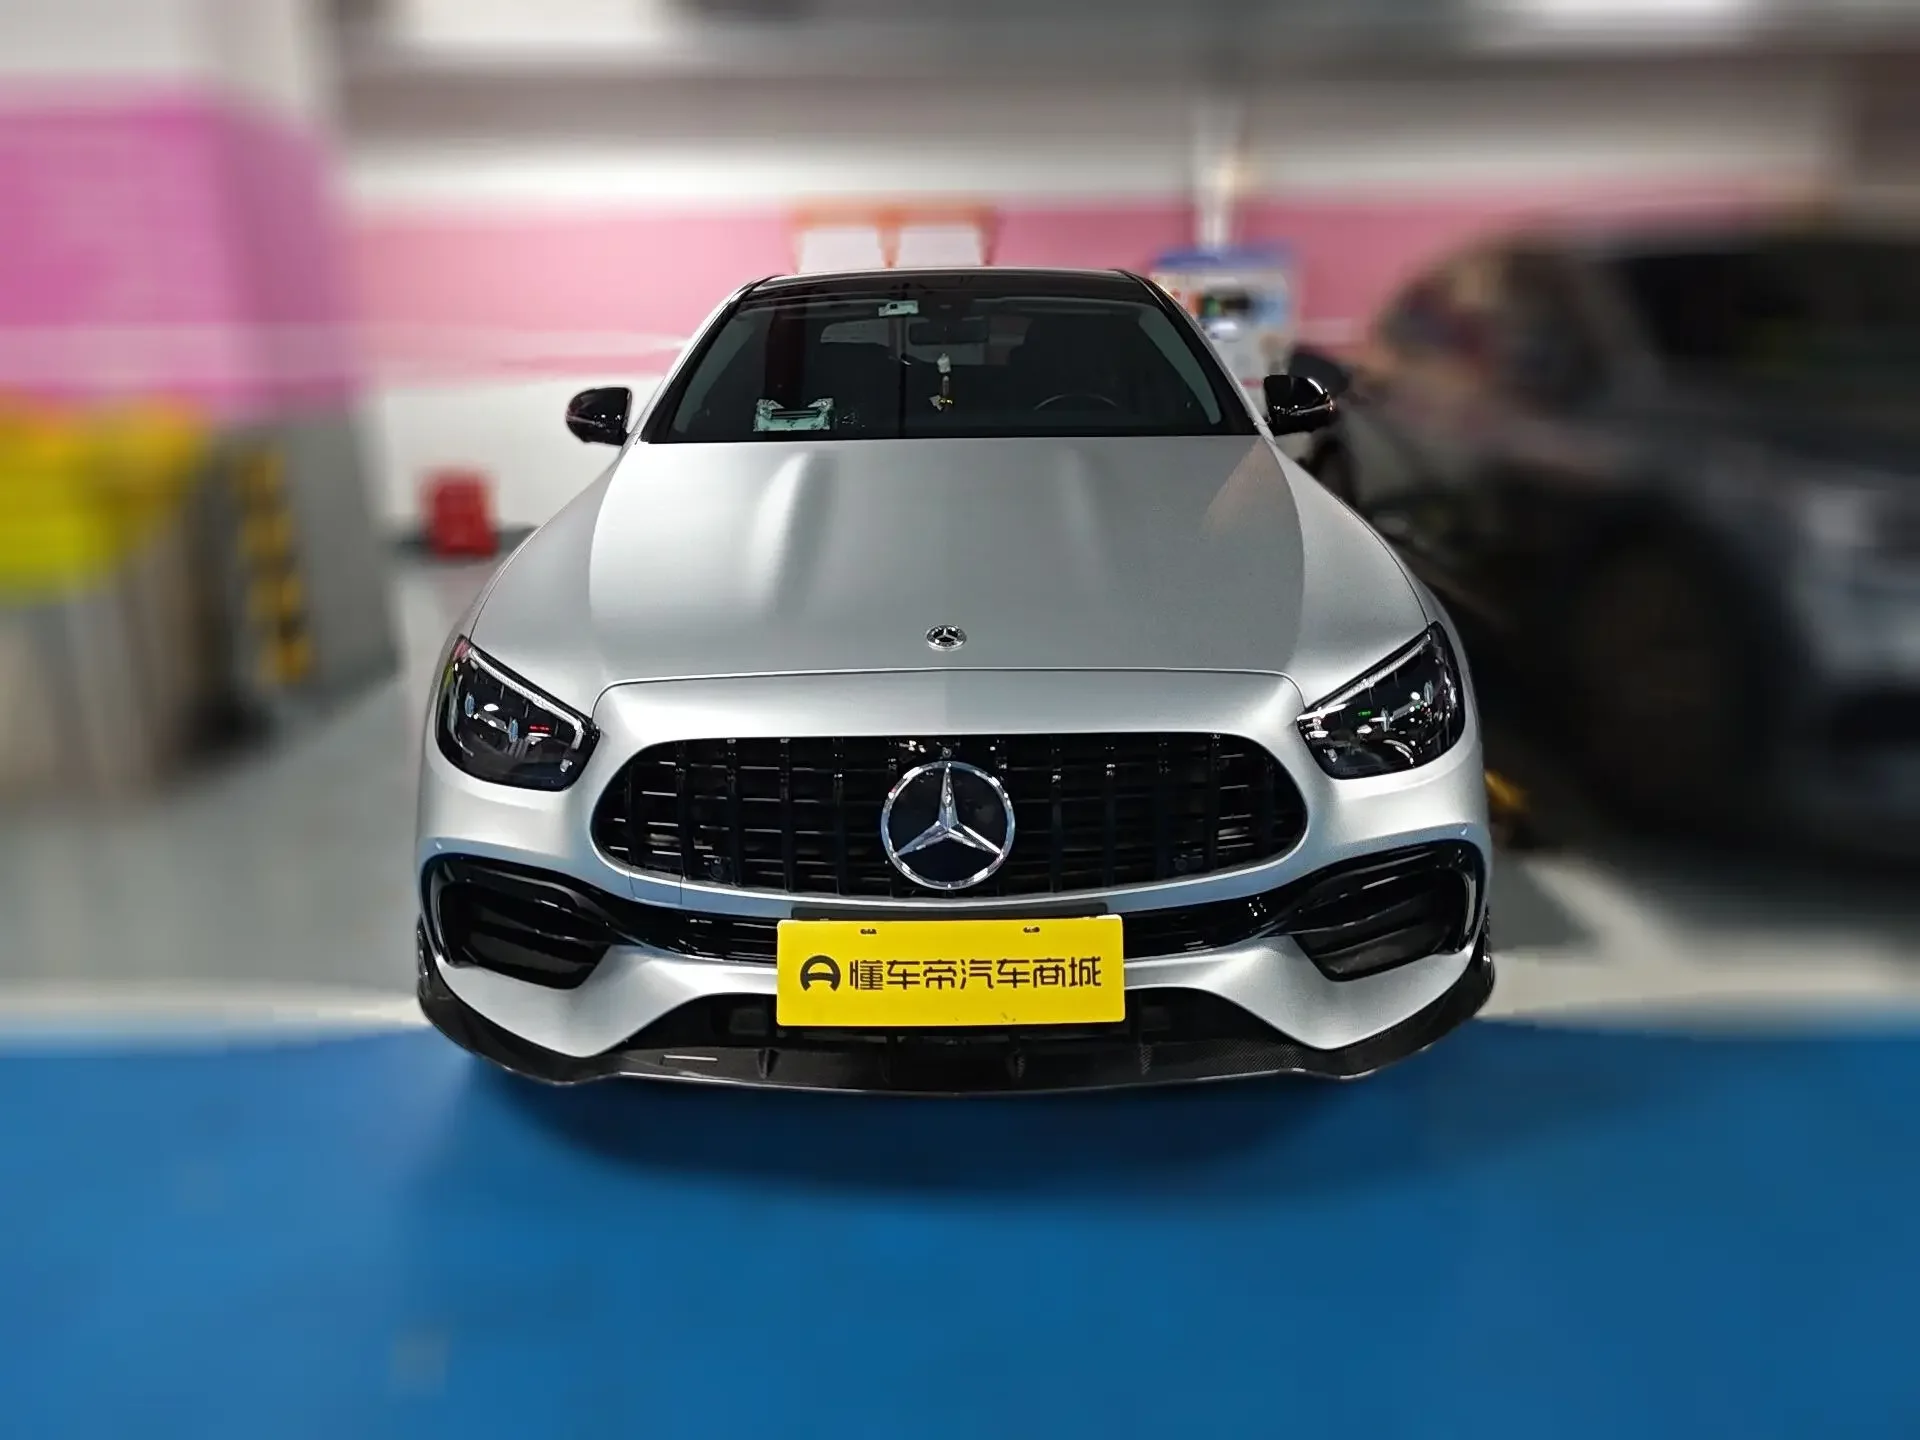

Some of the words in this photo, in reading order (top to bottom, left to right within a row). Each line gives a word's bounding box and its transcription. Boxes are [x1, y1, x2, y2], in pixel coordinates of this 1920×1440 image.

[849, 956, 1101, 990] 懂车帝汽车商城
